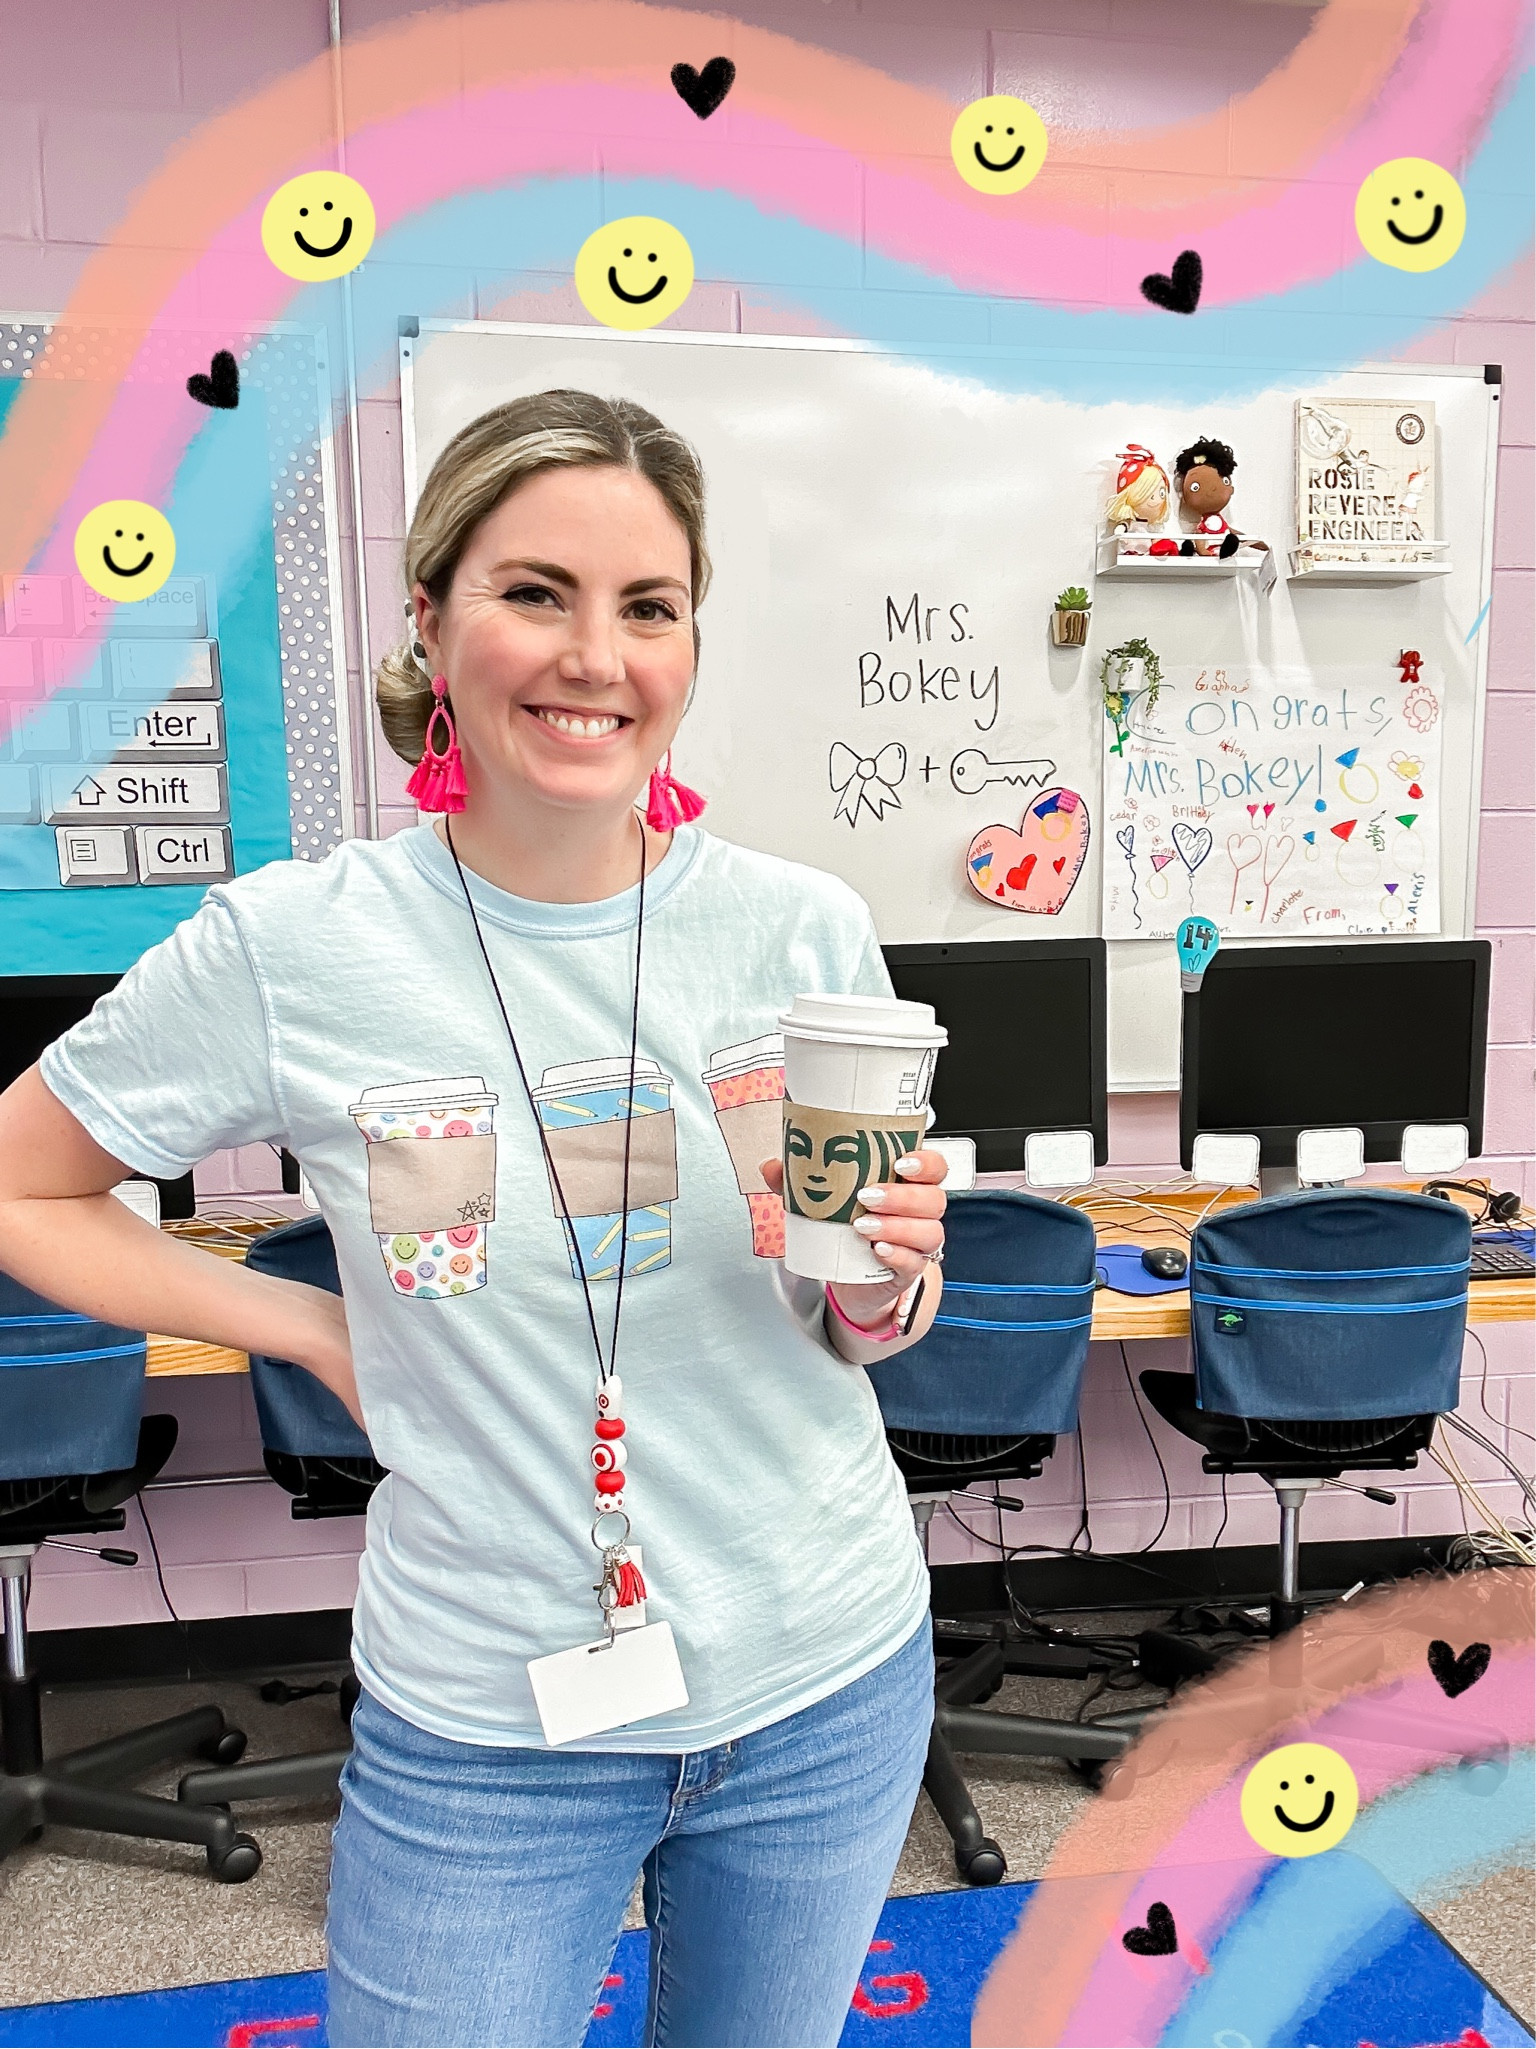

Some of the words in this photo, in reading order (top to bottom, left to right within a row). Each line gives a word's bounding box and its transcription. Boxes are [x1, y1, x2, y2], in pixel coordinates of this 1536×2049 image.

[1309, 468, 1375, 490] ROSIE
[1309, 520, 1424, 541] ENGINEER
[886, 593, 974, 643] Mrs.
[859, 652, 998, 731] Bokey
[107, 709, 197, 737] Enter
[117, 777, 189, 804] Shift
[1124, 759, 1185, 798] Mrs.
[1196, 744, 1327, 813] Bokey!
[157, 837, 210, 863] Ctrl
[1303, 906, 1346, 925] From,
[1183, 921, 1213, 951] 14
